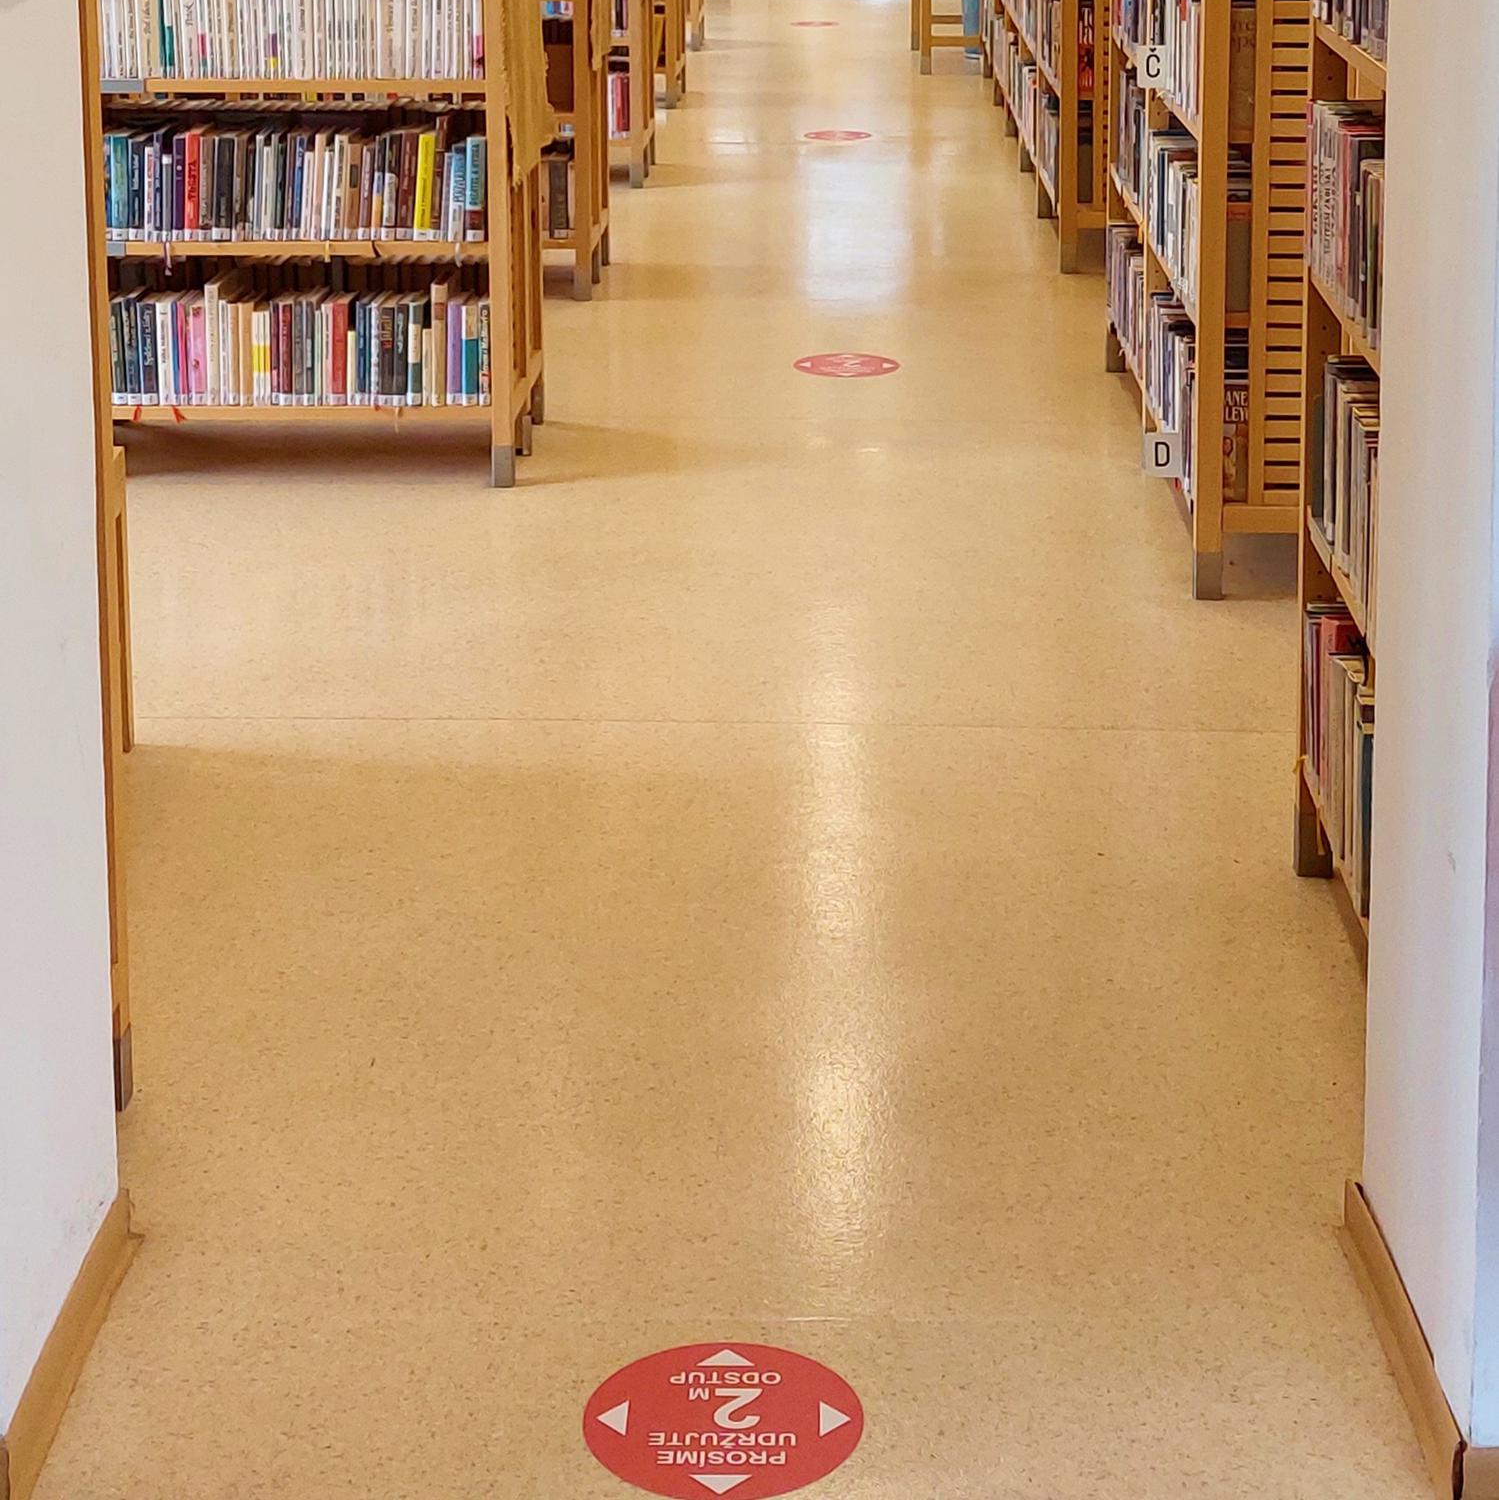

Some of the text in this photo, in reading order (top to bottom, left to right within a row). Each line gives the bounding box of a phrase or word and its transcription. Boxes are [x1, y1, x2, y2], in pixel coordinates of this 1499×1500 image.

[1146, 47, 1160, 78] Č
[1155, 441, 1170, 467] D
[669, 1371, 782, 1385] ODSTUP
[689, 1387, 763, 1430] 2 M
[648, 1432, 797, 1449] UDRŽUJTE
[656, 1450, 786, 1467] PROSÍME
